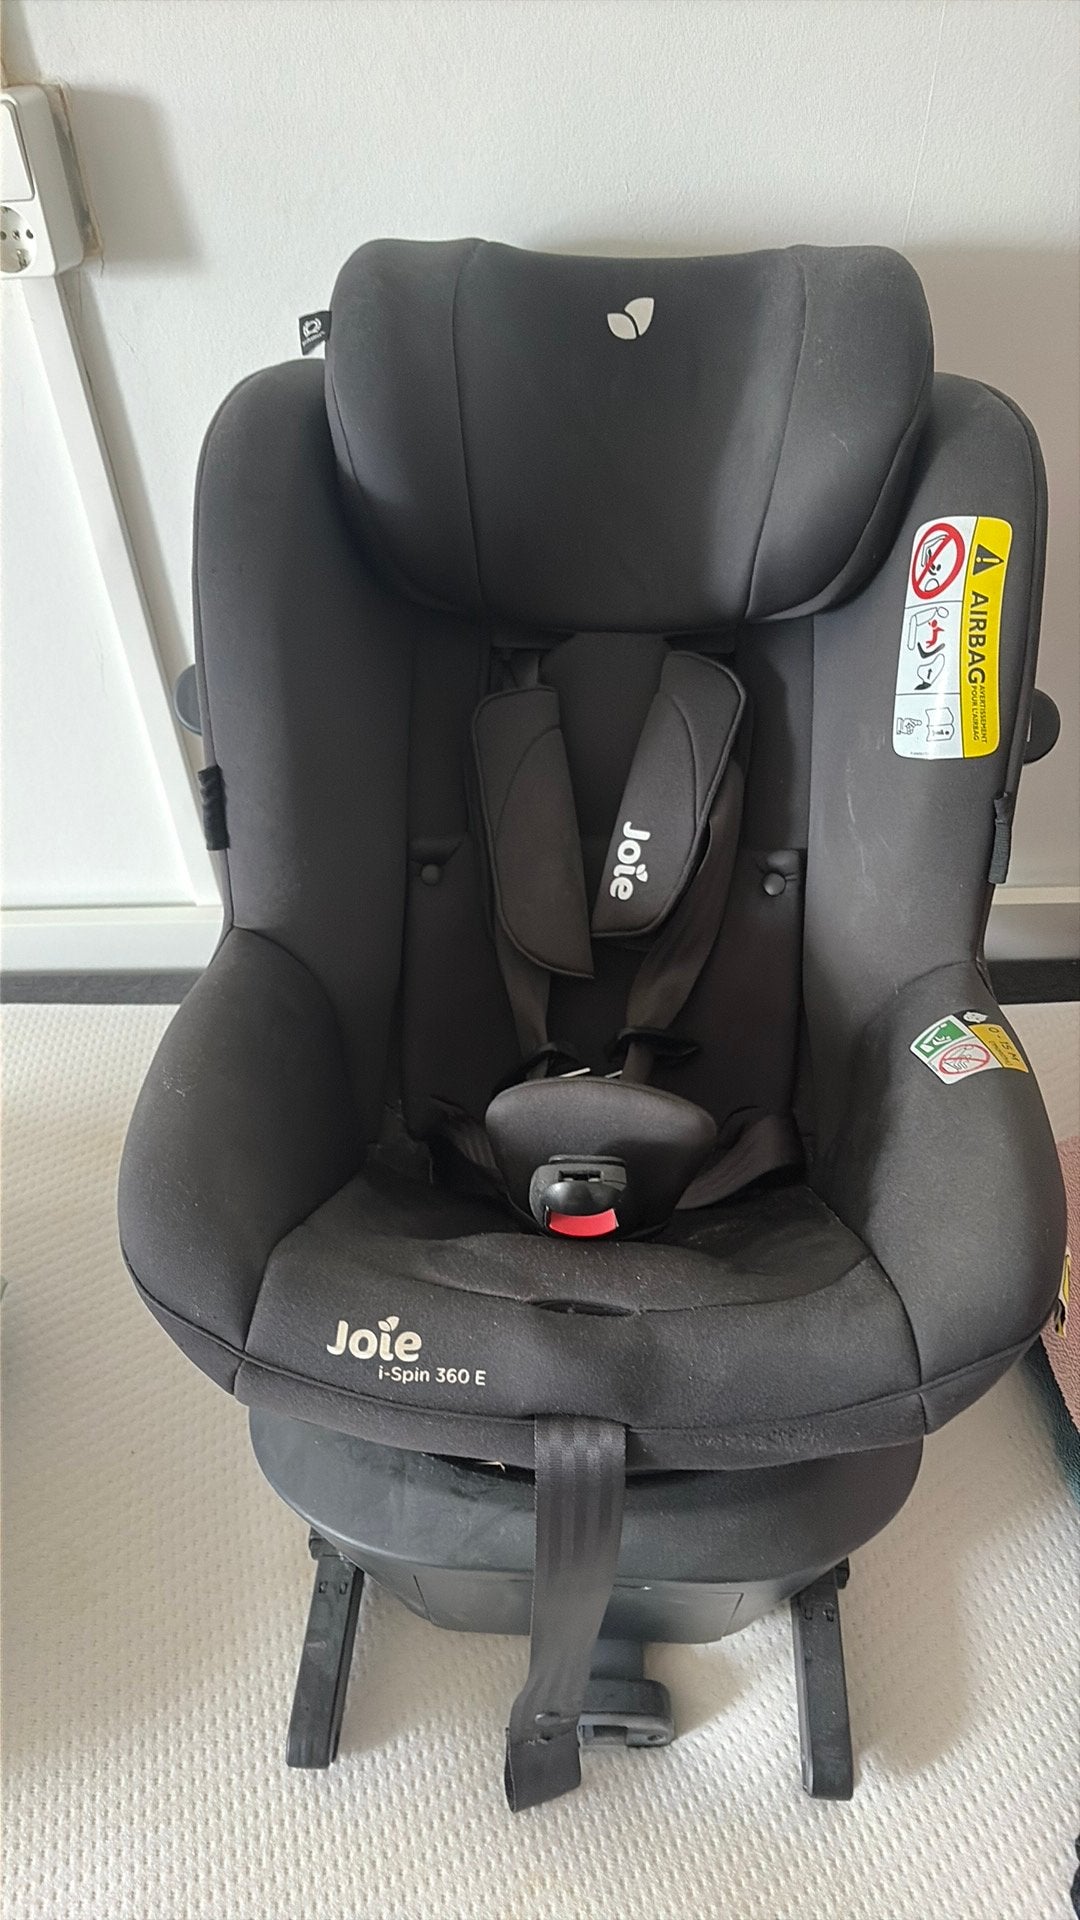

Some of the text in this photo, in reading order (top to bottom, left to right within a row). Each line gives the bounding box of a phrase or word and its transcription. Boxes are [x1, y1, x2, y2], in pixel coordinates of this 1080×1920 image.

[968, 590, 990, 684] AIRBAG
[971, 707, 979, 741] L'AIRBAG
[979, 685, 988, 743] AVERTISSEMENT
[609, 821, 651, 900] Joie
[326, 1316, 422, 1362] Joie
[378, 1365, 487, 1386] i-Spin 360 E
